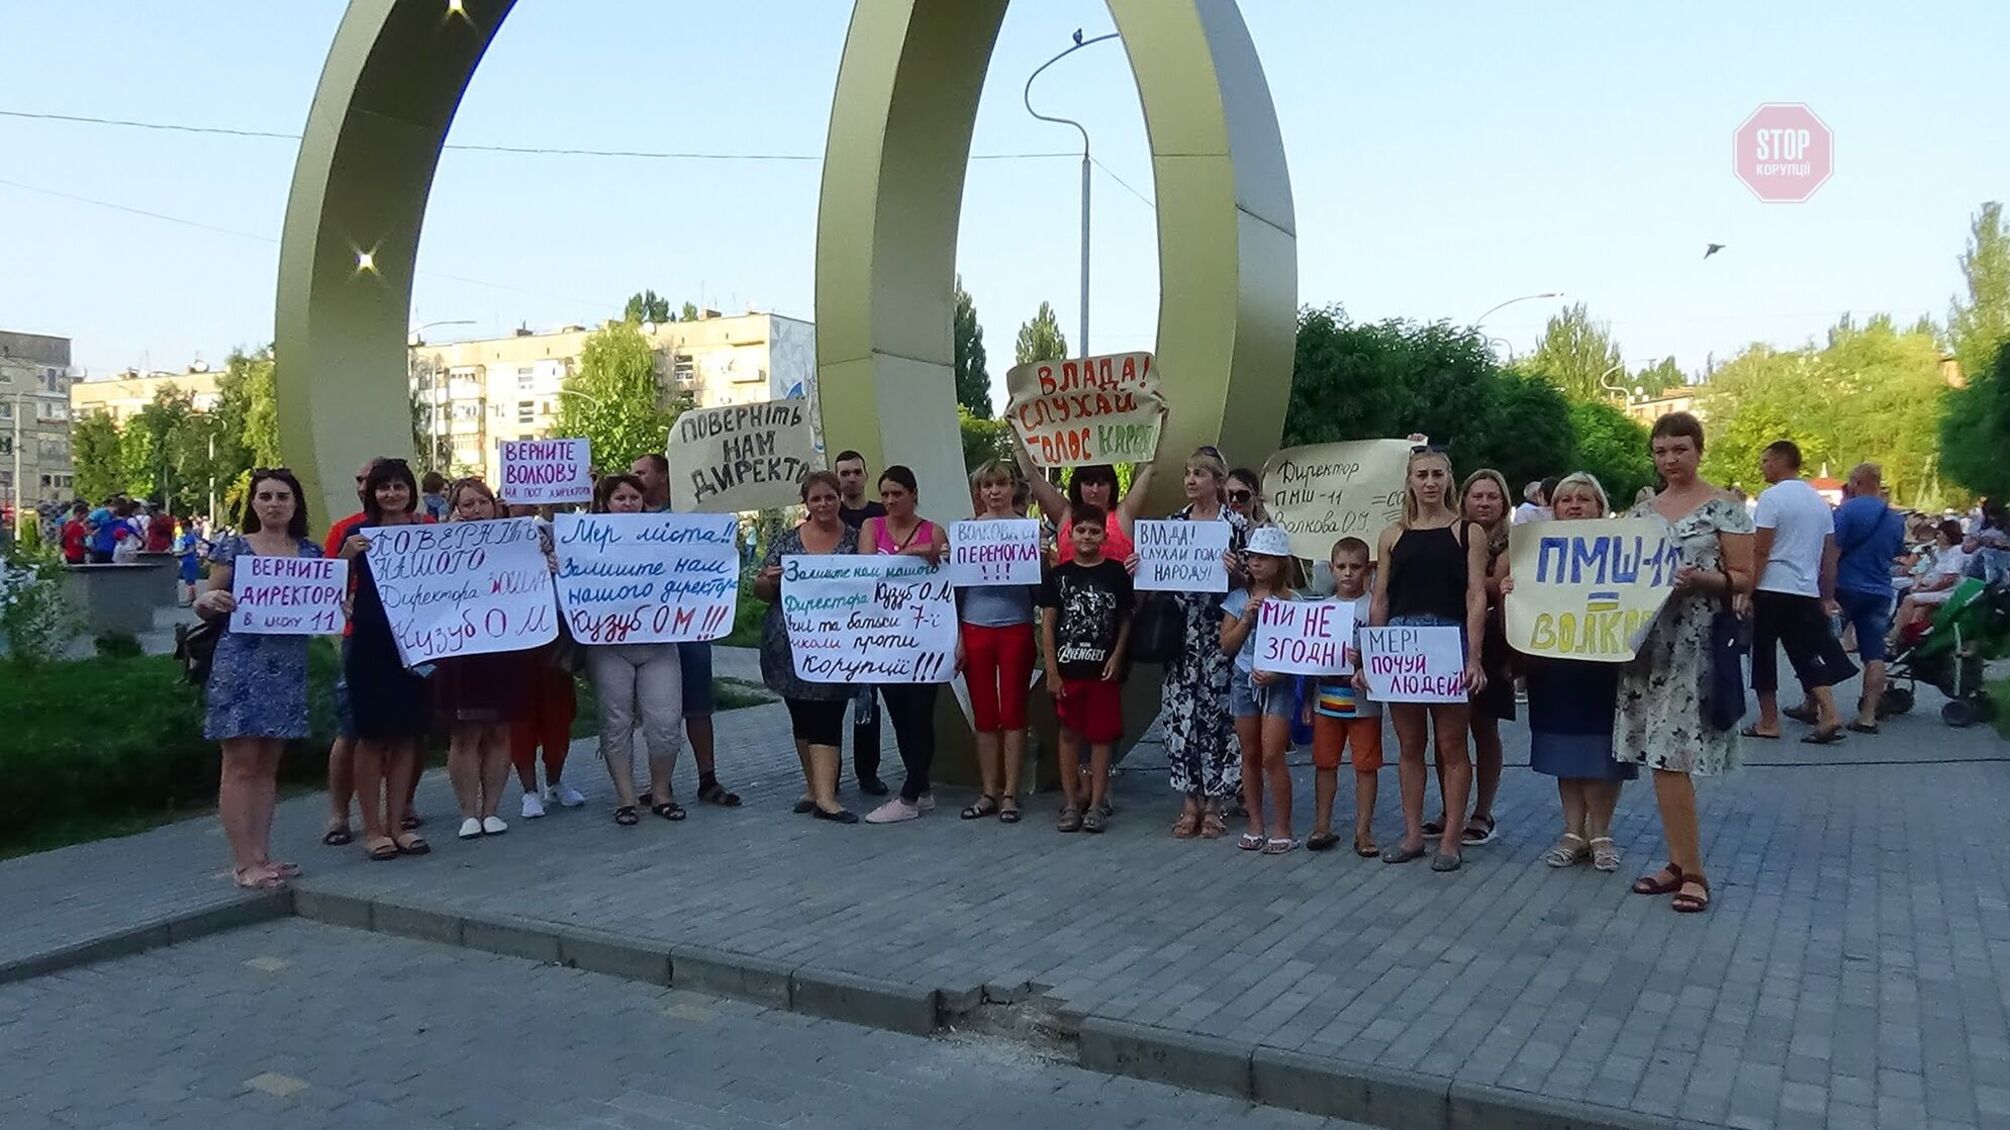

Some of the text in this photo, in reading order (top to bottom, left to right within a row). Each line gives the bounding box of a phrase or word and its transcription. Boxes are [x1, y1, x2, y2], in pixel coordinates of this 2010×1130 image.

[1037, 355, 1150, 396] ВЛАДА!
[1018, 387, 1138, 432] СЛУХАЙ
[506, 442, 576, 461] ВЕРНИТЕ
[722, 430, 776, 463] НАМ
[506, 463, 578, 485] ВОЛКОВУ
[1277, 460, 1360, 487] Директор
[504, 487, 518, 498] НА
[561, 519, 623, 553] Мер
[1140, 523, 1196, 546] ВЛАДА!
[373, 547, 486, 582] НАШОГО
[957, 544, 1038, 564] ПЕРЕМОГЛА
[252, 558, 334, 580] ВЕРНИТЕ
[674, 557, 731, 574] нам
[853, 567, 881, 578] нам
[886, 566, 940, 578] нашого
[1154, 564, 1213, 582] НАРОДУ!
[238, 586, 344, 607] ДИРЕКТОРА
[377, 580, 480, 615] Директора
[568, 582, 655, 604] нашого
[785, 593, 870, 616] Директора
[874, 582, 919, 611] Кузуб
[310, 610, 336, 631] 11
[393, 604, 551, 656] Кузуб О М
[569, 604, 651, 642] Кузуб
[817, 620, 842, 633] та
[847, 611, 900, 630] батьки
[1262, 601, 1297, 626] МИ
[1303, 606, 1336, 638] НЕ
[853, 634, 920, 655] проти
[1369, 629, 1418, 653] МЕР!
[1057, 643, 1106, 663] AVENGERS
[1264, 637, 1346, 668] ЗГОДНІ
[1371, 653, 1427, 675] ПОЧУЙ
[1390, 670, 1468, 697] ЛЮДЕЙ!
